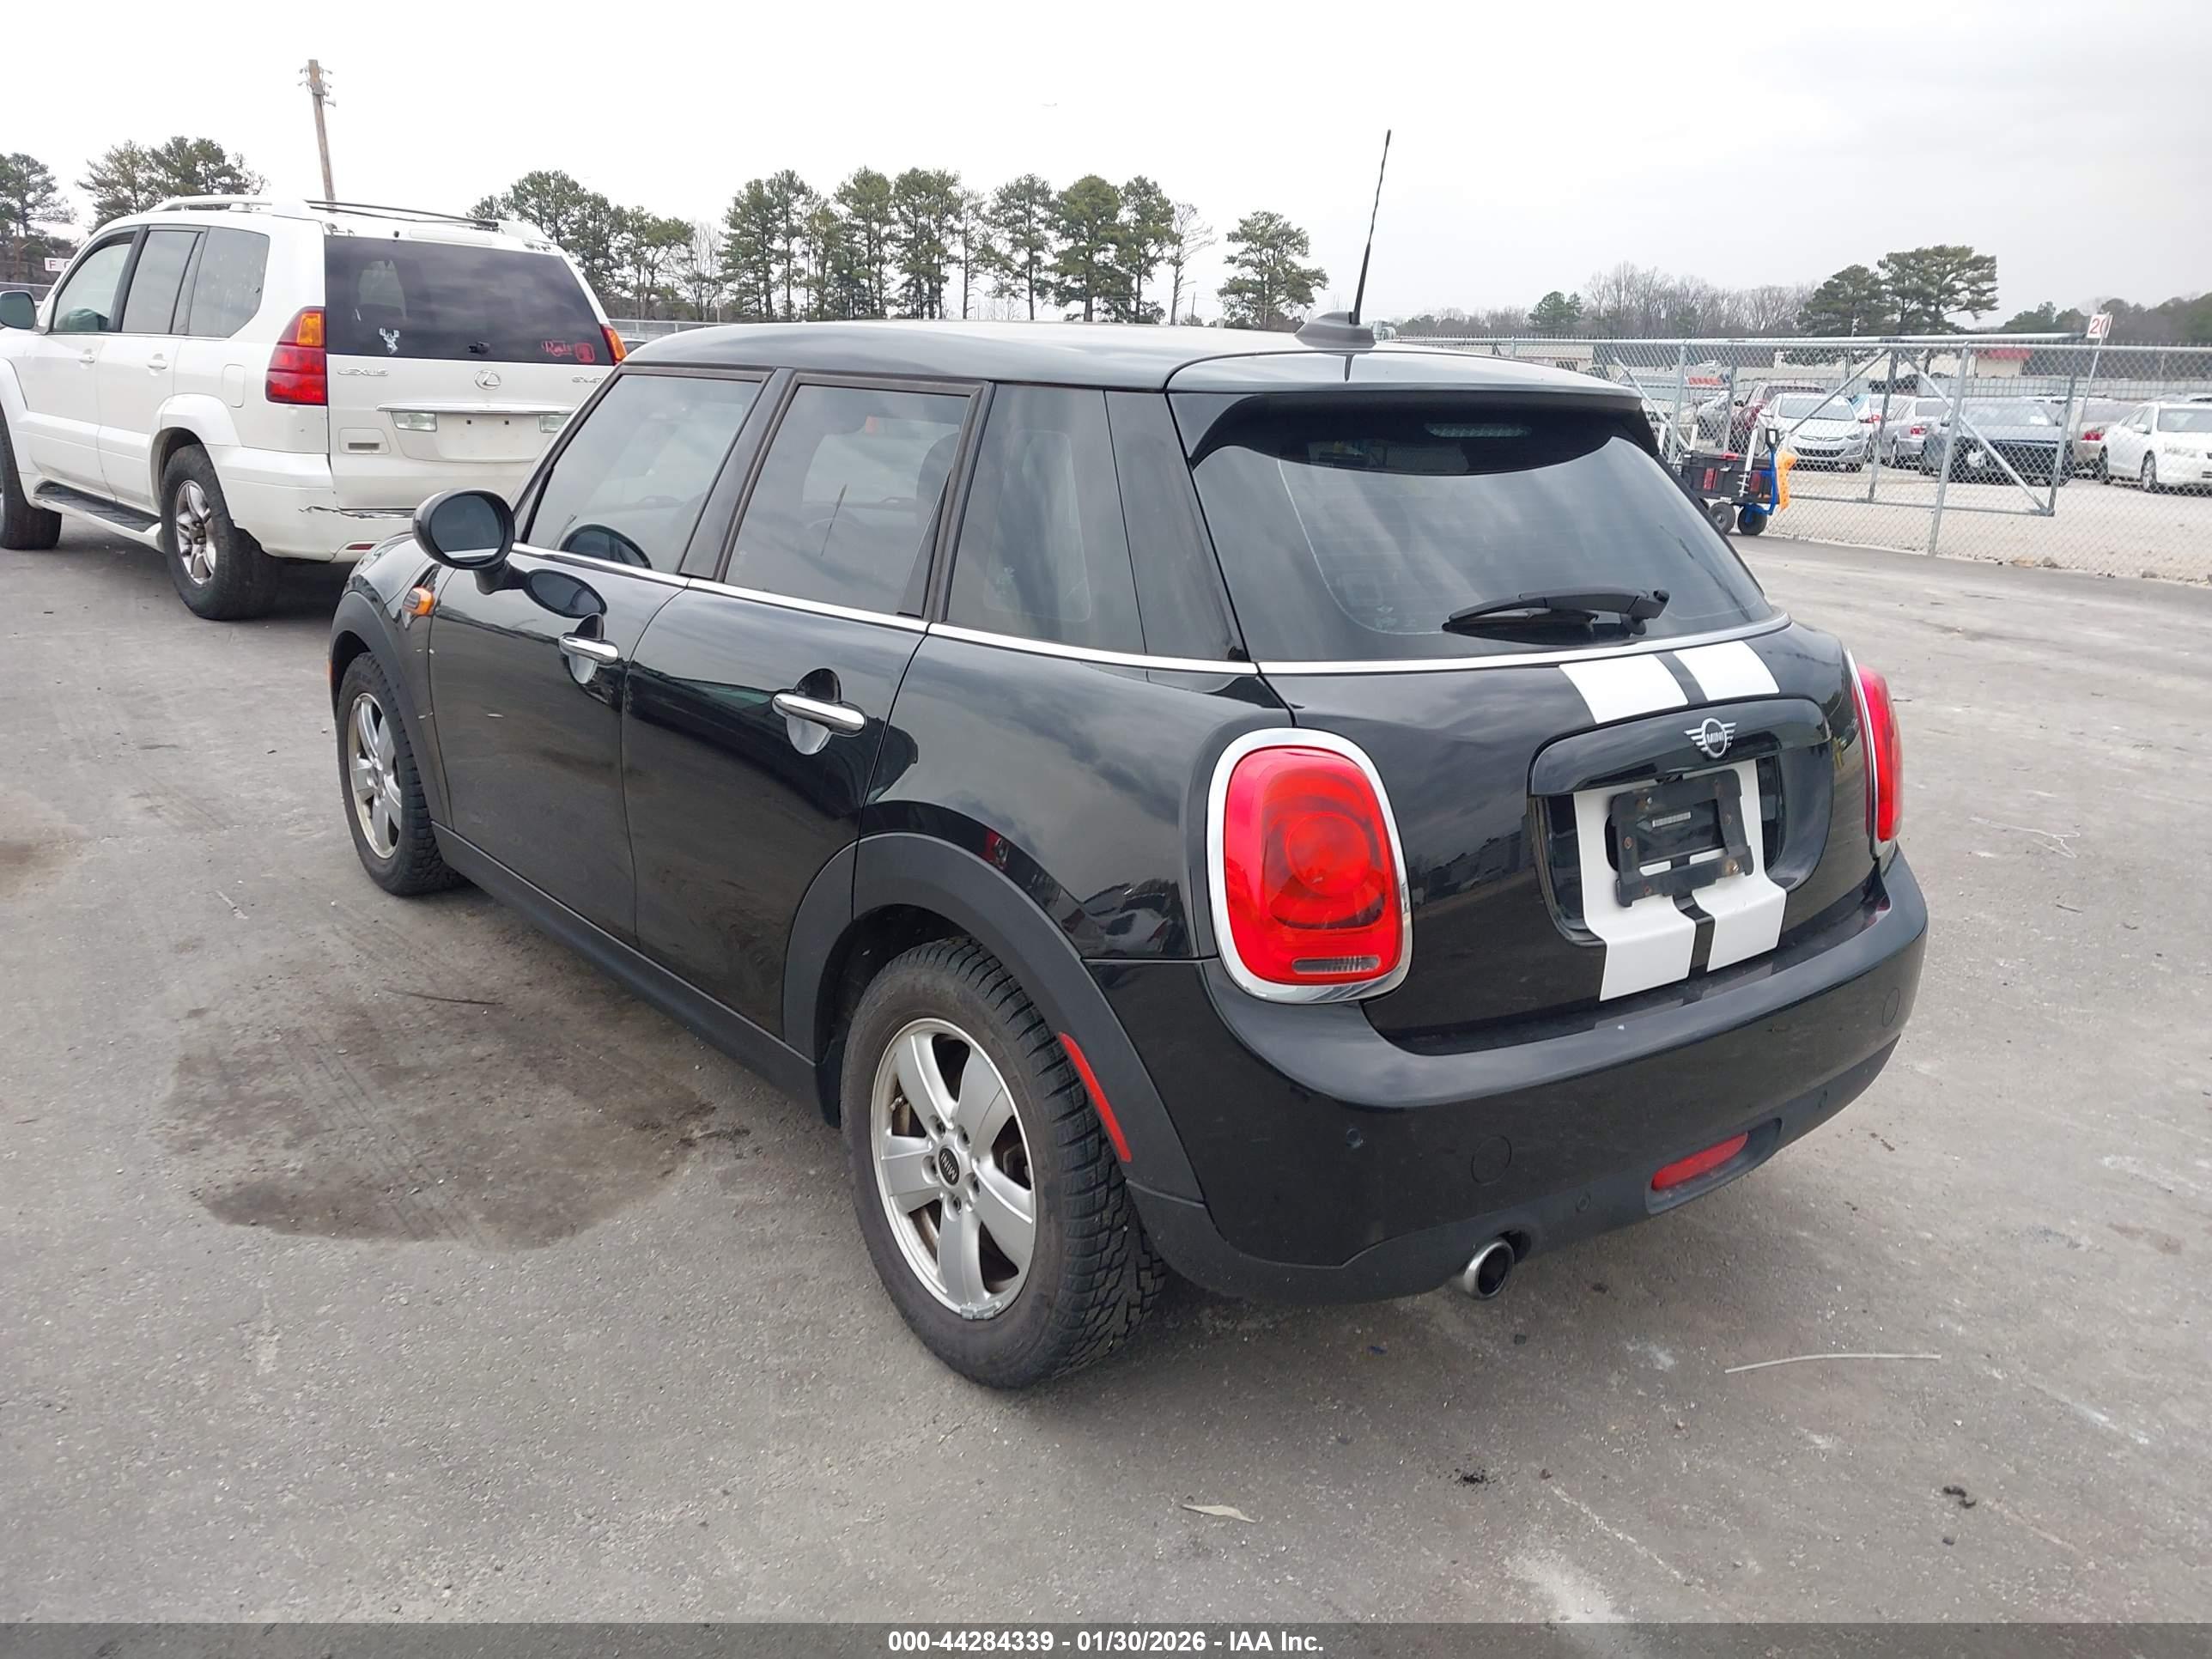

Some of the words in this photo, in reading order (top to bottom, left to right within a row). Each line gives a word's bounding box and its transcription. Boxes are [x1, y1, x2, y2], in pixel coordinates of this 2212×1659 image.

[337, 367, 389, 377] LEXUS
[1706, 732, 1724, 744] MINI
[940, 1152, 957, 1181] MINI
